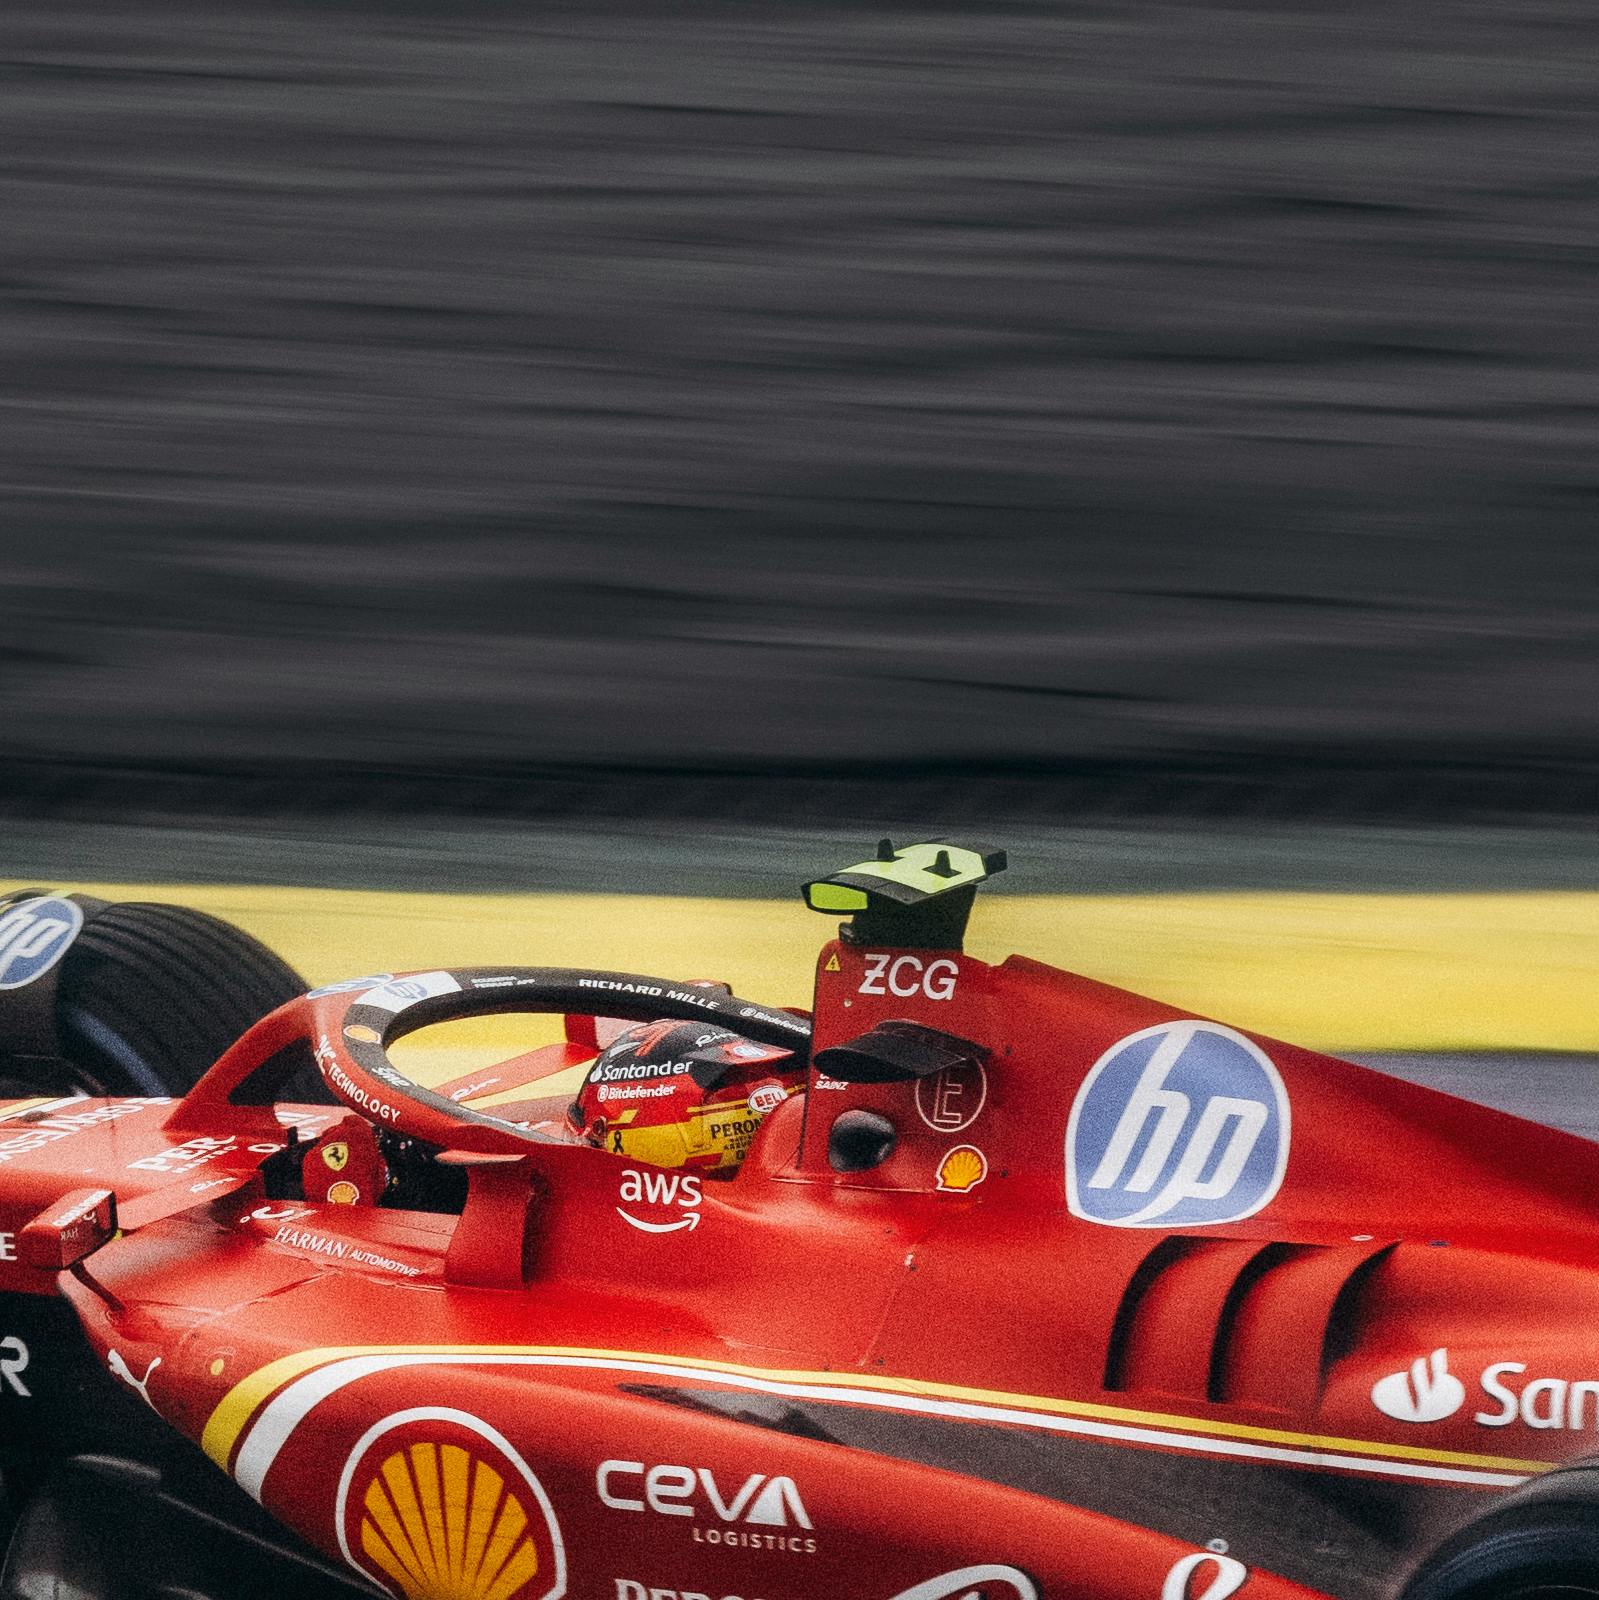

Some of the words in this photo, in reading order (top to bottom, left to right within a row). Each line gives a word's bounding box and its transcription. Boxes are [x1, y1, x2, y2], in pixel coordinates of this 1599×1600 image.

[578, 978, 663, 997] RICHARD
[665, 990, 721, 1010] MILLE
[858, 953, 959, 1001] ZCG
[602, 1060, 694, 1081] Santander
[327, 1062, 401, 1122] TECHNOLOGY
[608, 1084, 677, 1100] Bitdefender
[1087, 1026, 1269, 1223] hp
[619, 1169, 703, 1208] aws
[273, 1226, 347, 1259] HARMAN
[349, 1250, 420, 1277] AUTOMOTIVE
[692, 1526, 818, 1554] LOGISTICS
